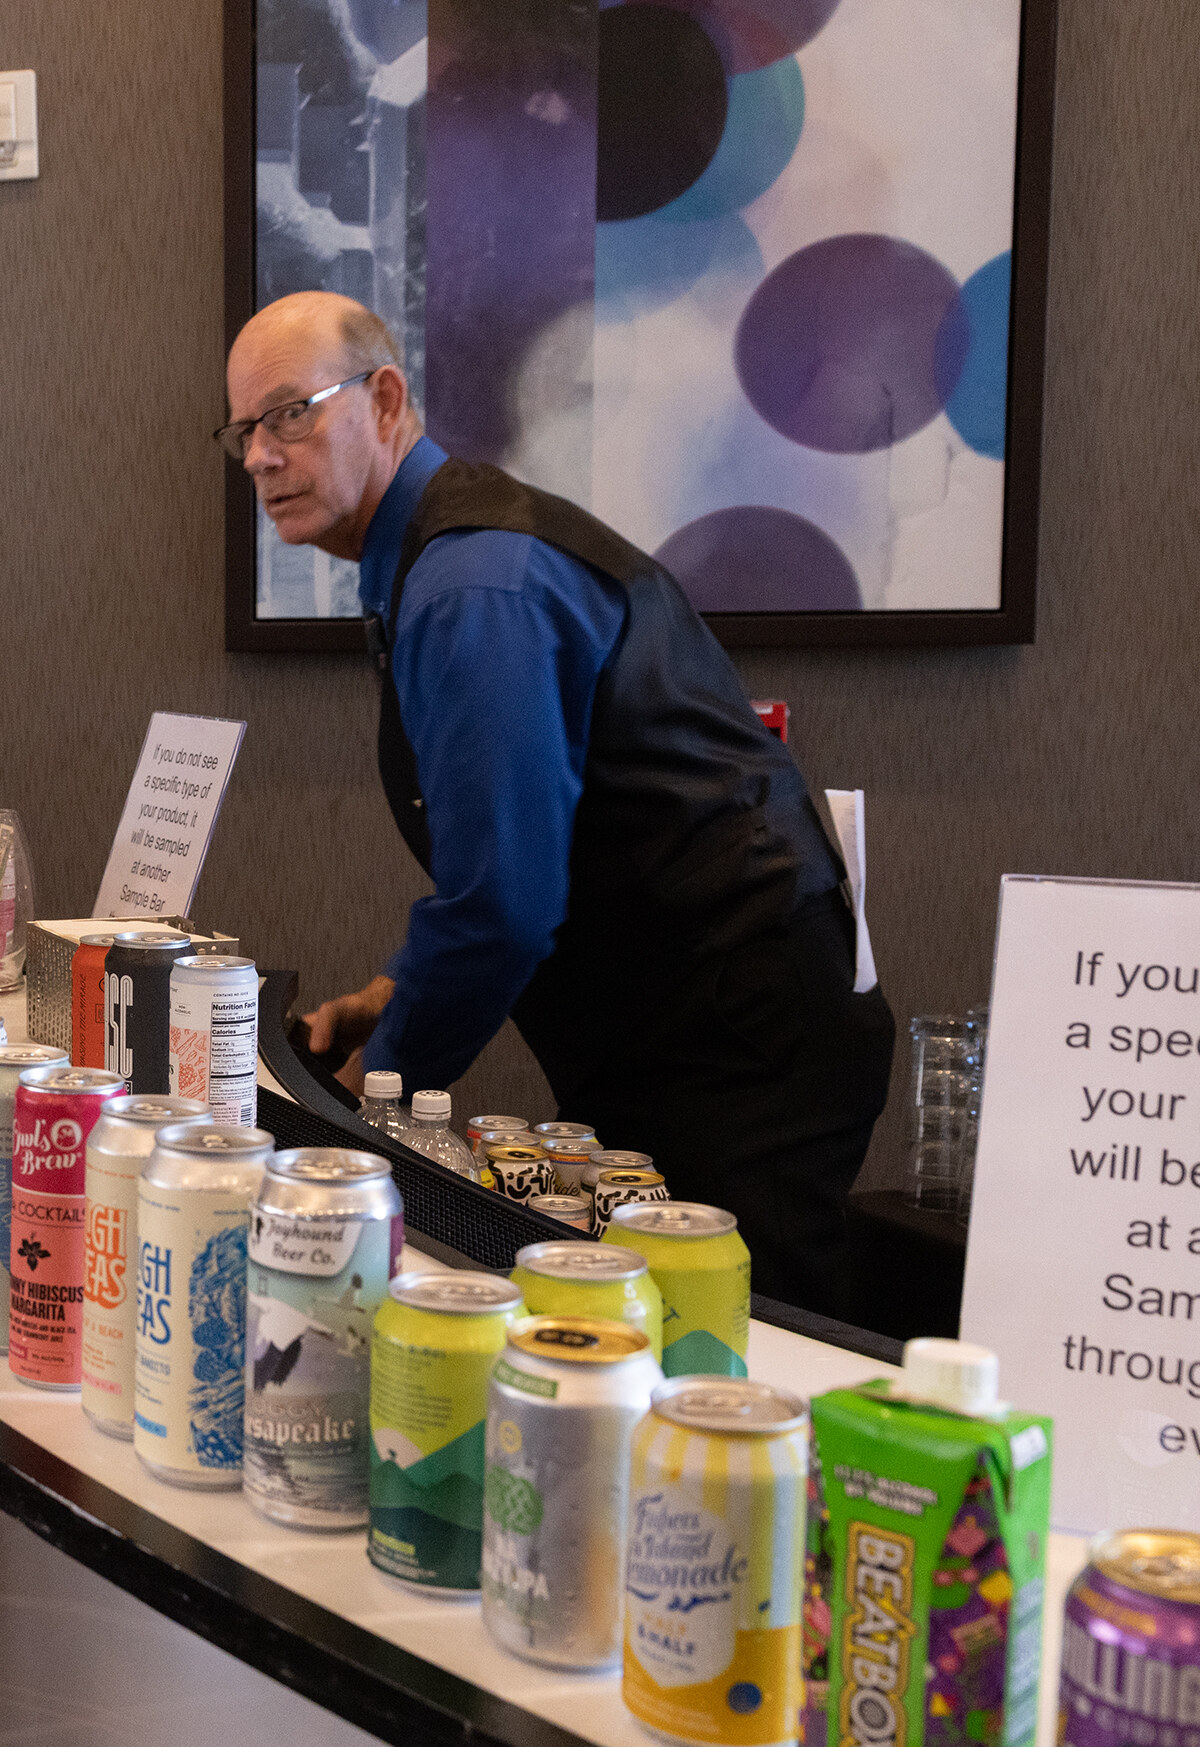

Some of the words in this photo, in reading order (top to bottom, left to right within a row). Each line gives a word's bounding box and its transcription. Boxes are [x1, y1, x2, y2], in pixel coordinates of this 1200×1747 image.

[153, 743, 162, 760] If
[158, 749, 174, 765] you
[175, 748, 186, 765] do
[187, 752, 201, 767] not
[201, 755, 219, 770] see
[144, 775, 150, 787] a
[151, 775, 181, 795] specific
[181, 780, 199, 800] type
[200, 782, 213, 799] of
[138, 802, 157, 819] your
[156, 806, 189, 828] product,
[190, 813, 198, 828] it
[130, 828, 144, 843] will
[144, 832, 154, 848] be
[154, 836, 191, 857] sampled
[131, 859, 140, 875] at
[139, 863, 171, 883] another
[120, 884, 150, 907] Sample
[149, 892, 166, 912] Bar
[1075, 951, 1104, 986] If
[1116, 961, 1200, 998] you
[212, 1003, 243, 1011] Nutrition
[1065, 1021, 1091, 1049] a
[1109, 1024, 1200, 1062] spe
[1081, 1086, 1186, 1122] your
[21, 1149, 76, 1175] Brew
[1070, 1143, 1141, 1181] will
[1127, 1216, 1170, 1250] at
[273, 1243, 305, 1262] Beer
[310, 1248, 336, 1265] Co.
[28, 1282, 84, 1303] HIBISCUS
